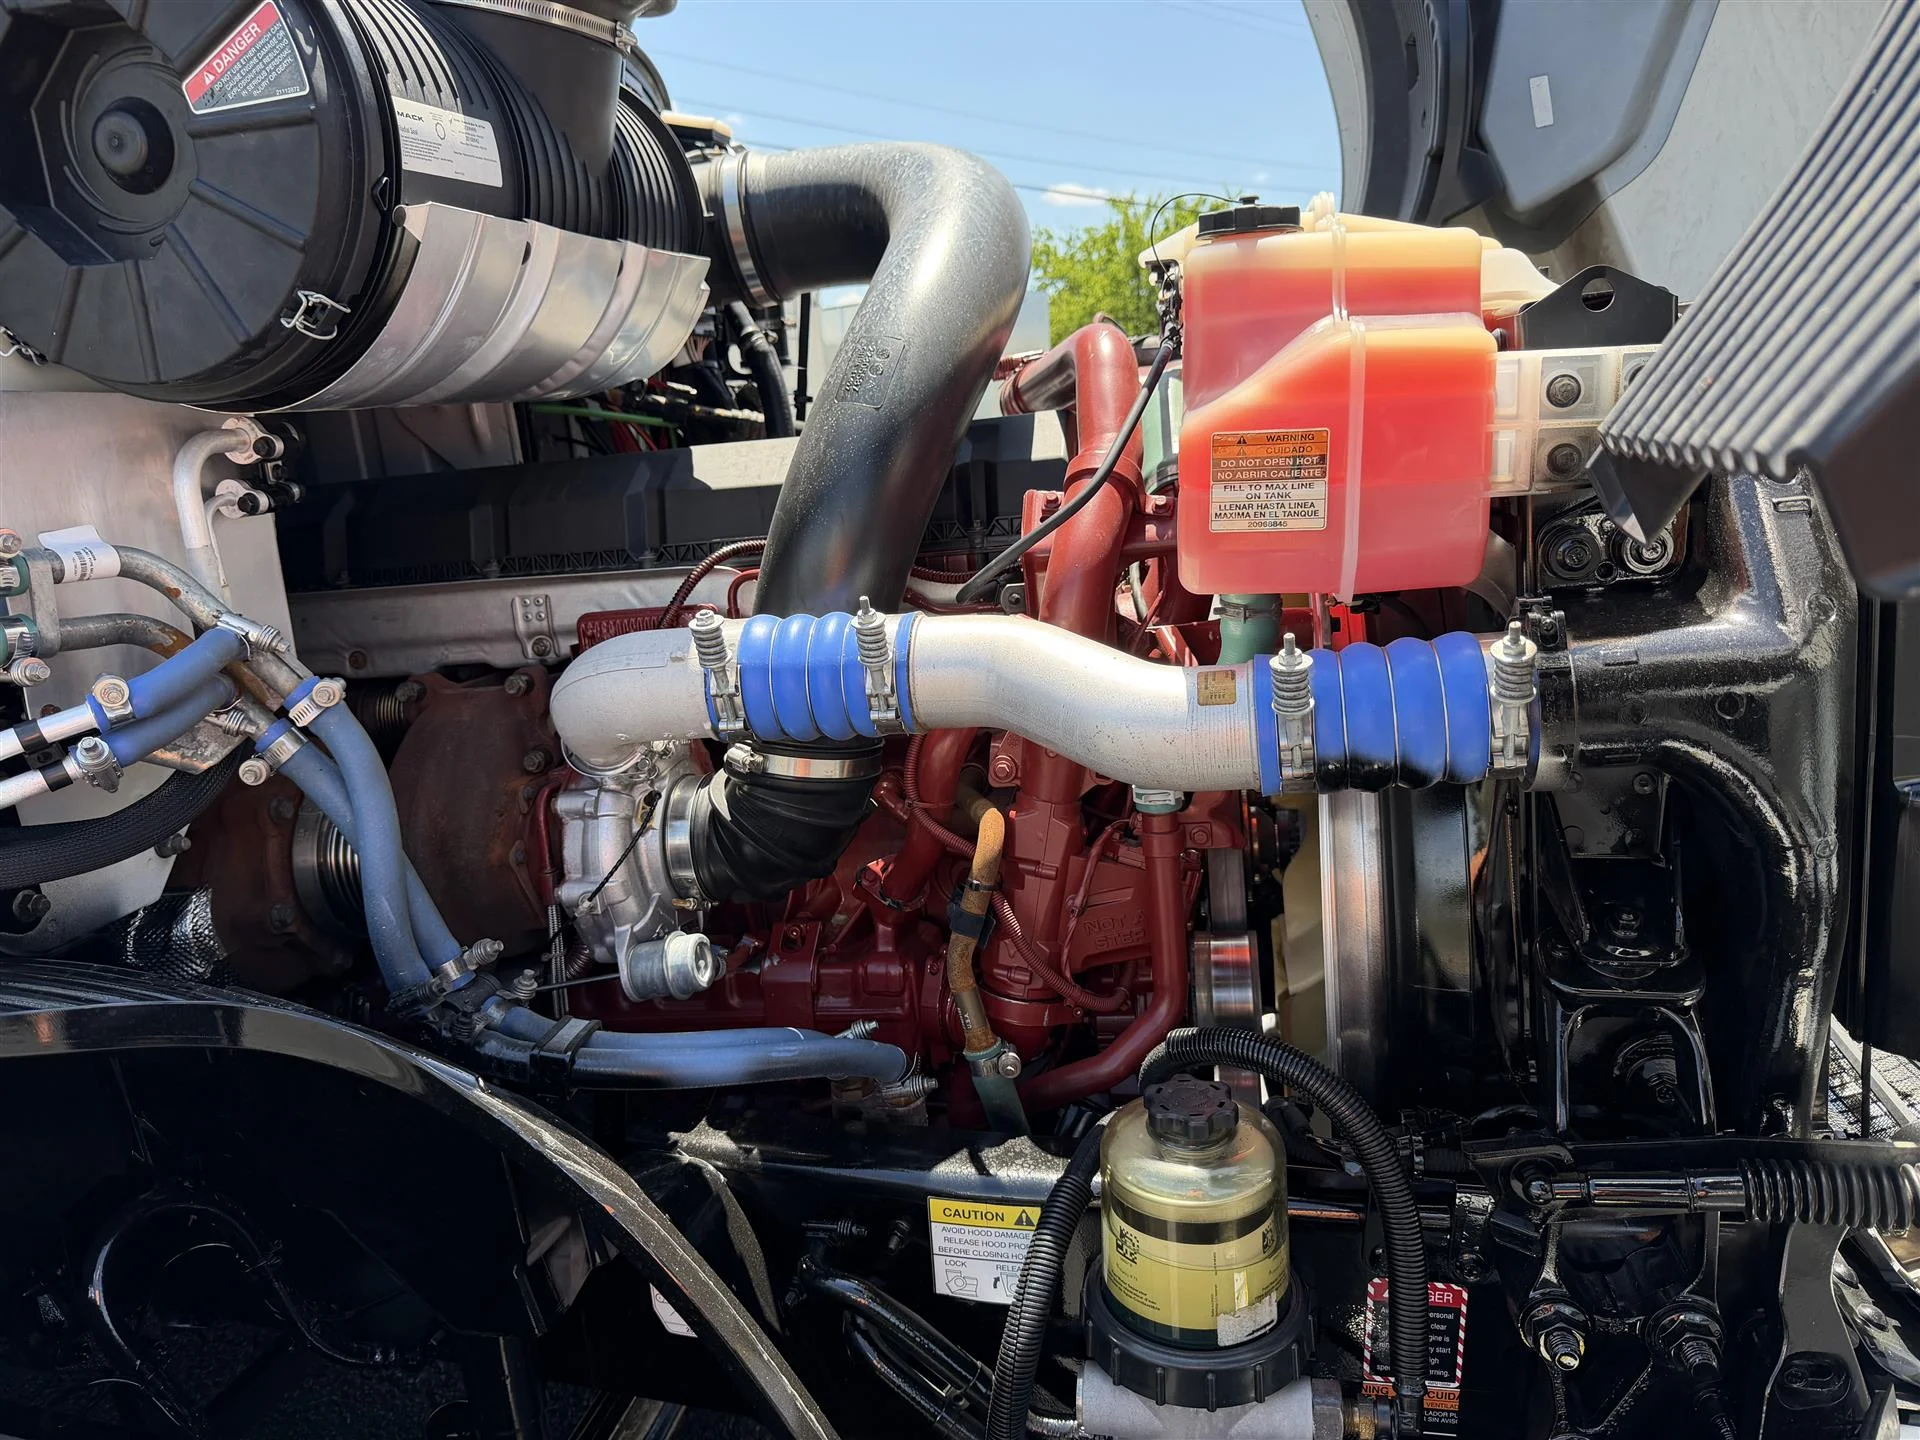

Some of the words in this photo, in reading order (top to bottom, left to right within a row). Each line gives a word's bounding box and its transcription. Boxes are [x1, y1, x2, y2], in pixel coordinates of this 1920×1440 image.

[212, 22, 262, 73] DANGER
[262, 38, 289, 64] RESULTING
[215, 80, 222, 91] DO
[222, 71, 232, 83] NOT
[231, 62, 242, 74] USE
[240, 48, 257, 65] ETHER
[255, 32, 271, 50] WHICH
[270, 22, 282, 34] CAN
[225, 74, 242, 91] CAUSE
[240, 56, 258, 76] ENGINE
[257, 39, 278, 60] DAMAGE
[247, 70, 268, 92] SERIOUS
[266, 48, 291, 72] PERSONAL
[252, 79, 270, 96] INJURY
[396, 110, 424, 122] MACK
[1266, 433, 1315, 442] WARNING
[1266, 445, 1313, 455] CUIDADO
[1220, 460, 1236, 468] DO
[1240, 459, 1260, 467] NOT
[1264, 458, 1293, 466] OPEN
[1296, 457, 1318, 465] HOT
[1218, 472, 1232, 480] NO
[1236, 470, 1267, 479] ABRIR
[1271, 469, 1321, 478] CALIENTE
[1219, 503, 1254, 511] LLENAR
[1257, 502, 1286, 510] HASTA
[1282, 510, 1319, 518] TANQUE
[1084, 914, 1126, 934] NOT
[1095, 929, 1146, 949] STEP
[943, 1207, 1005, 1222] CAUTION
[941, 1226, 966, 1235] AVOID
[968, 1228, 992, 1237] HOOD
[994, 1231, 1030, 1240] DAMAGE
[944, 1236, 979, 1246] RELEASE
[982, 1240, 1006, 1248] HOOD
[938, 1246, 970, 1256] BEFORE
[972, 1249, 1009, 1259] CLOSING
[1011, 1252, 1026, 1260] HO
[944, 1259, 967, 1267] LOCK
[996, 1264, 1021, 1272] RELEA
[1428, 1290, 1453, 1303] GER
[1362, 1385, 1388, 1394] NING
